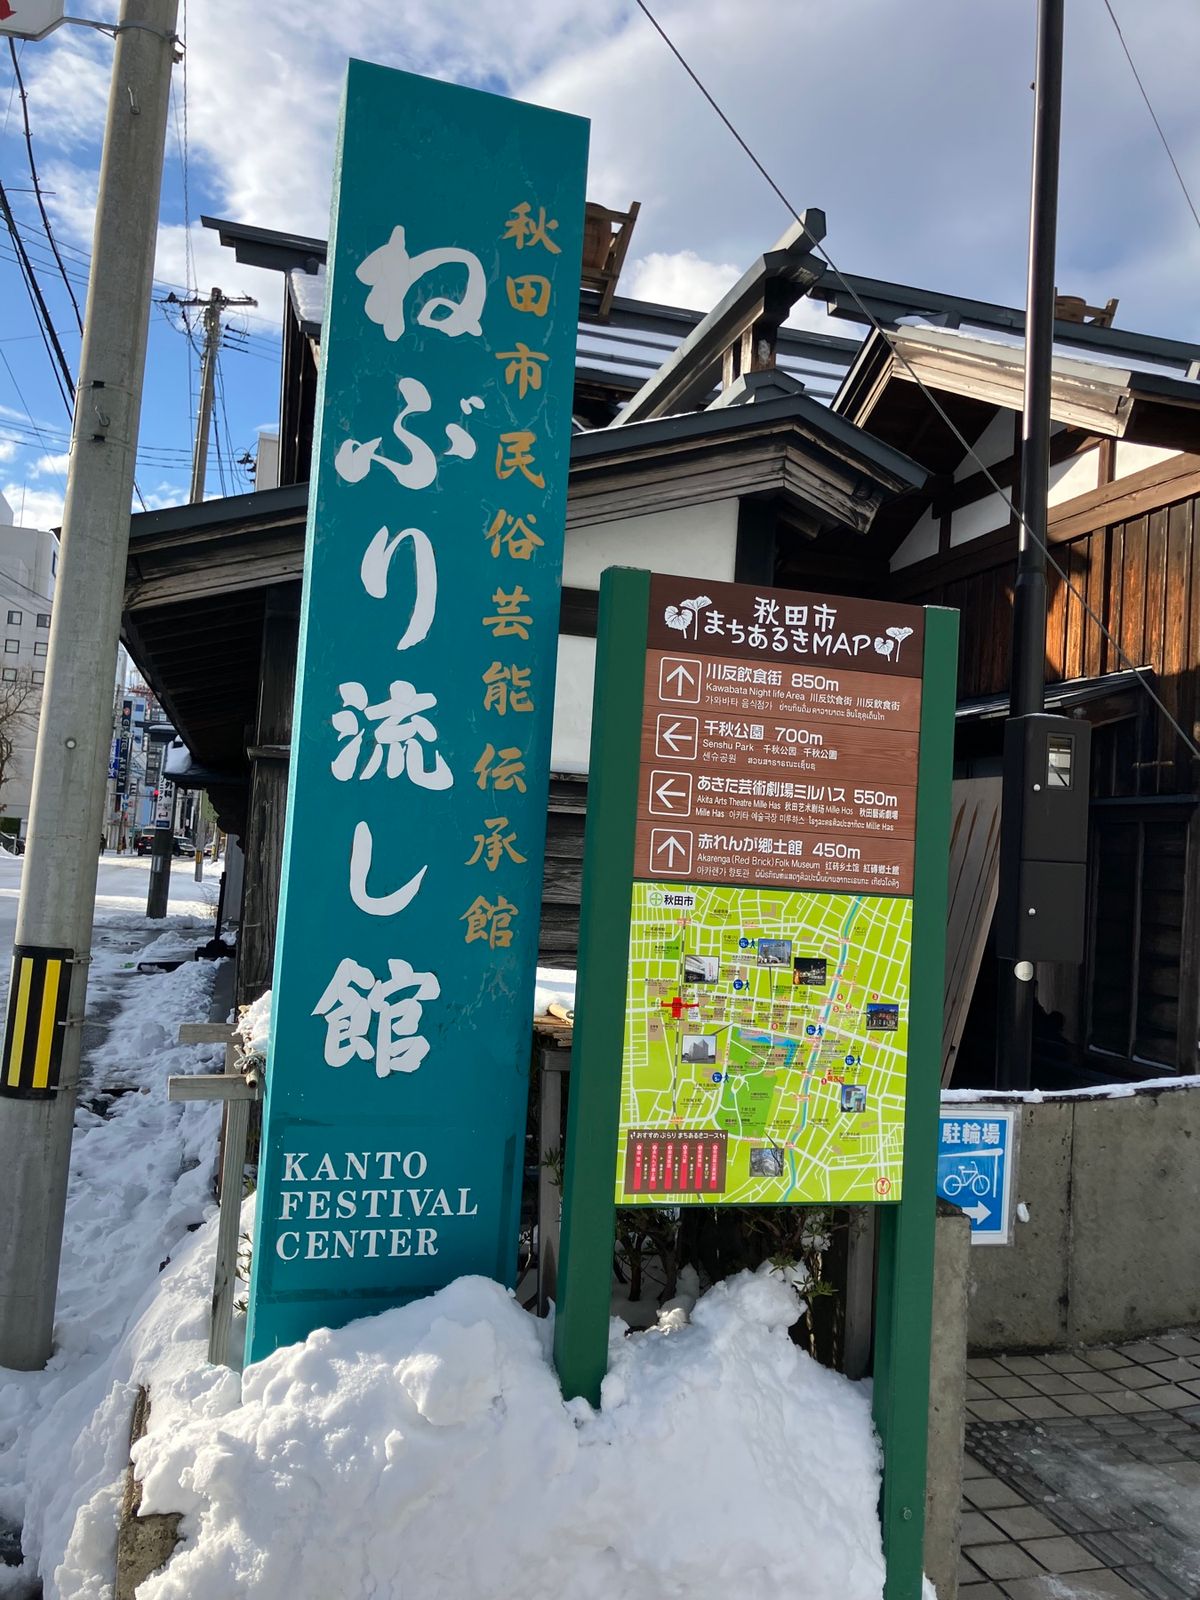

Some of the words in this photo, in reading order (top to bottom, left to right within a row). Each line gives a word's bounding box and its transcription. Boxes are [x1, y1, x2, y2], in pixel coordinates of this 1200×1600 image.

[459, 201, 562, 949] 秋田市民俗芸能伝承館
[753, 596, 837, 632] 秋田市
[704, 610, 871, 656] まちあるきMAP
[312, 225, 487, 1078] ねぶり流し館
[706, 663, 782, 686] 川反飲食街
[791, 672, 839, 692] 850m
[706, 683, 748, 695] Kawabata
[749, 687, 771, 698] Night
[785, 690, 805, 701] Area
[703, 739, 733, 751] Senshu
[735, 742, 754, 752] Park
[704, 720, 765, 740] 千秋公園
[774, 727, 823, 746] 700m
[697, 775, 846, 803] あきた芸術劇場ミルハス
[853, 789, 898, 807] 550m
[697, 795, 713, 805] Akita
[714, 796, 728, 806] Arts
[729, 797, 751, 808] Theatre
[753, 799, 767, 809] Mille
[768, 801, 781, 811] Has
[695, 807, 711, 817] Mille
[712, 809, 725, 819] Has
[698, 833, 803, 856] 赤れんが郷土館
[812, 842, 861, 860] 450m
[791, 859, 820, 870] Museum
[664, 894, 693, 907] 秋田市
[942, 1122, 1000, 1145] 駐輪場
[281, 1150, 428, 1182] KANTO
[279, 1187, 478, 1221] FESTIVAL
[276, 1228, 439, 1261] CENTER
